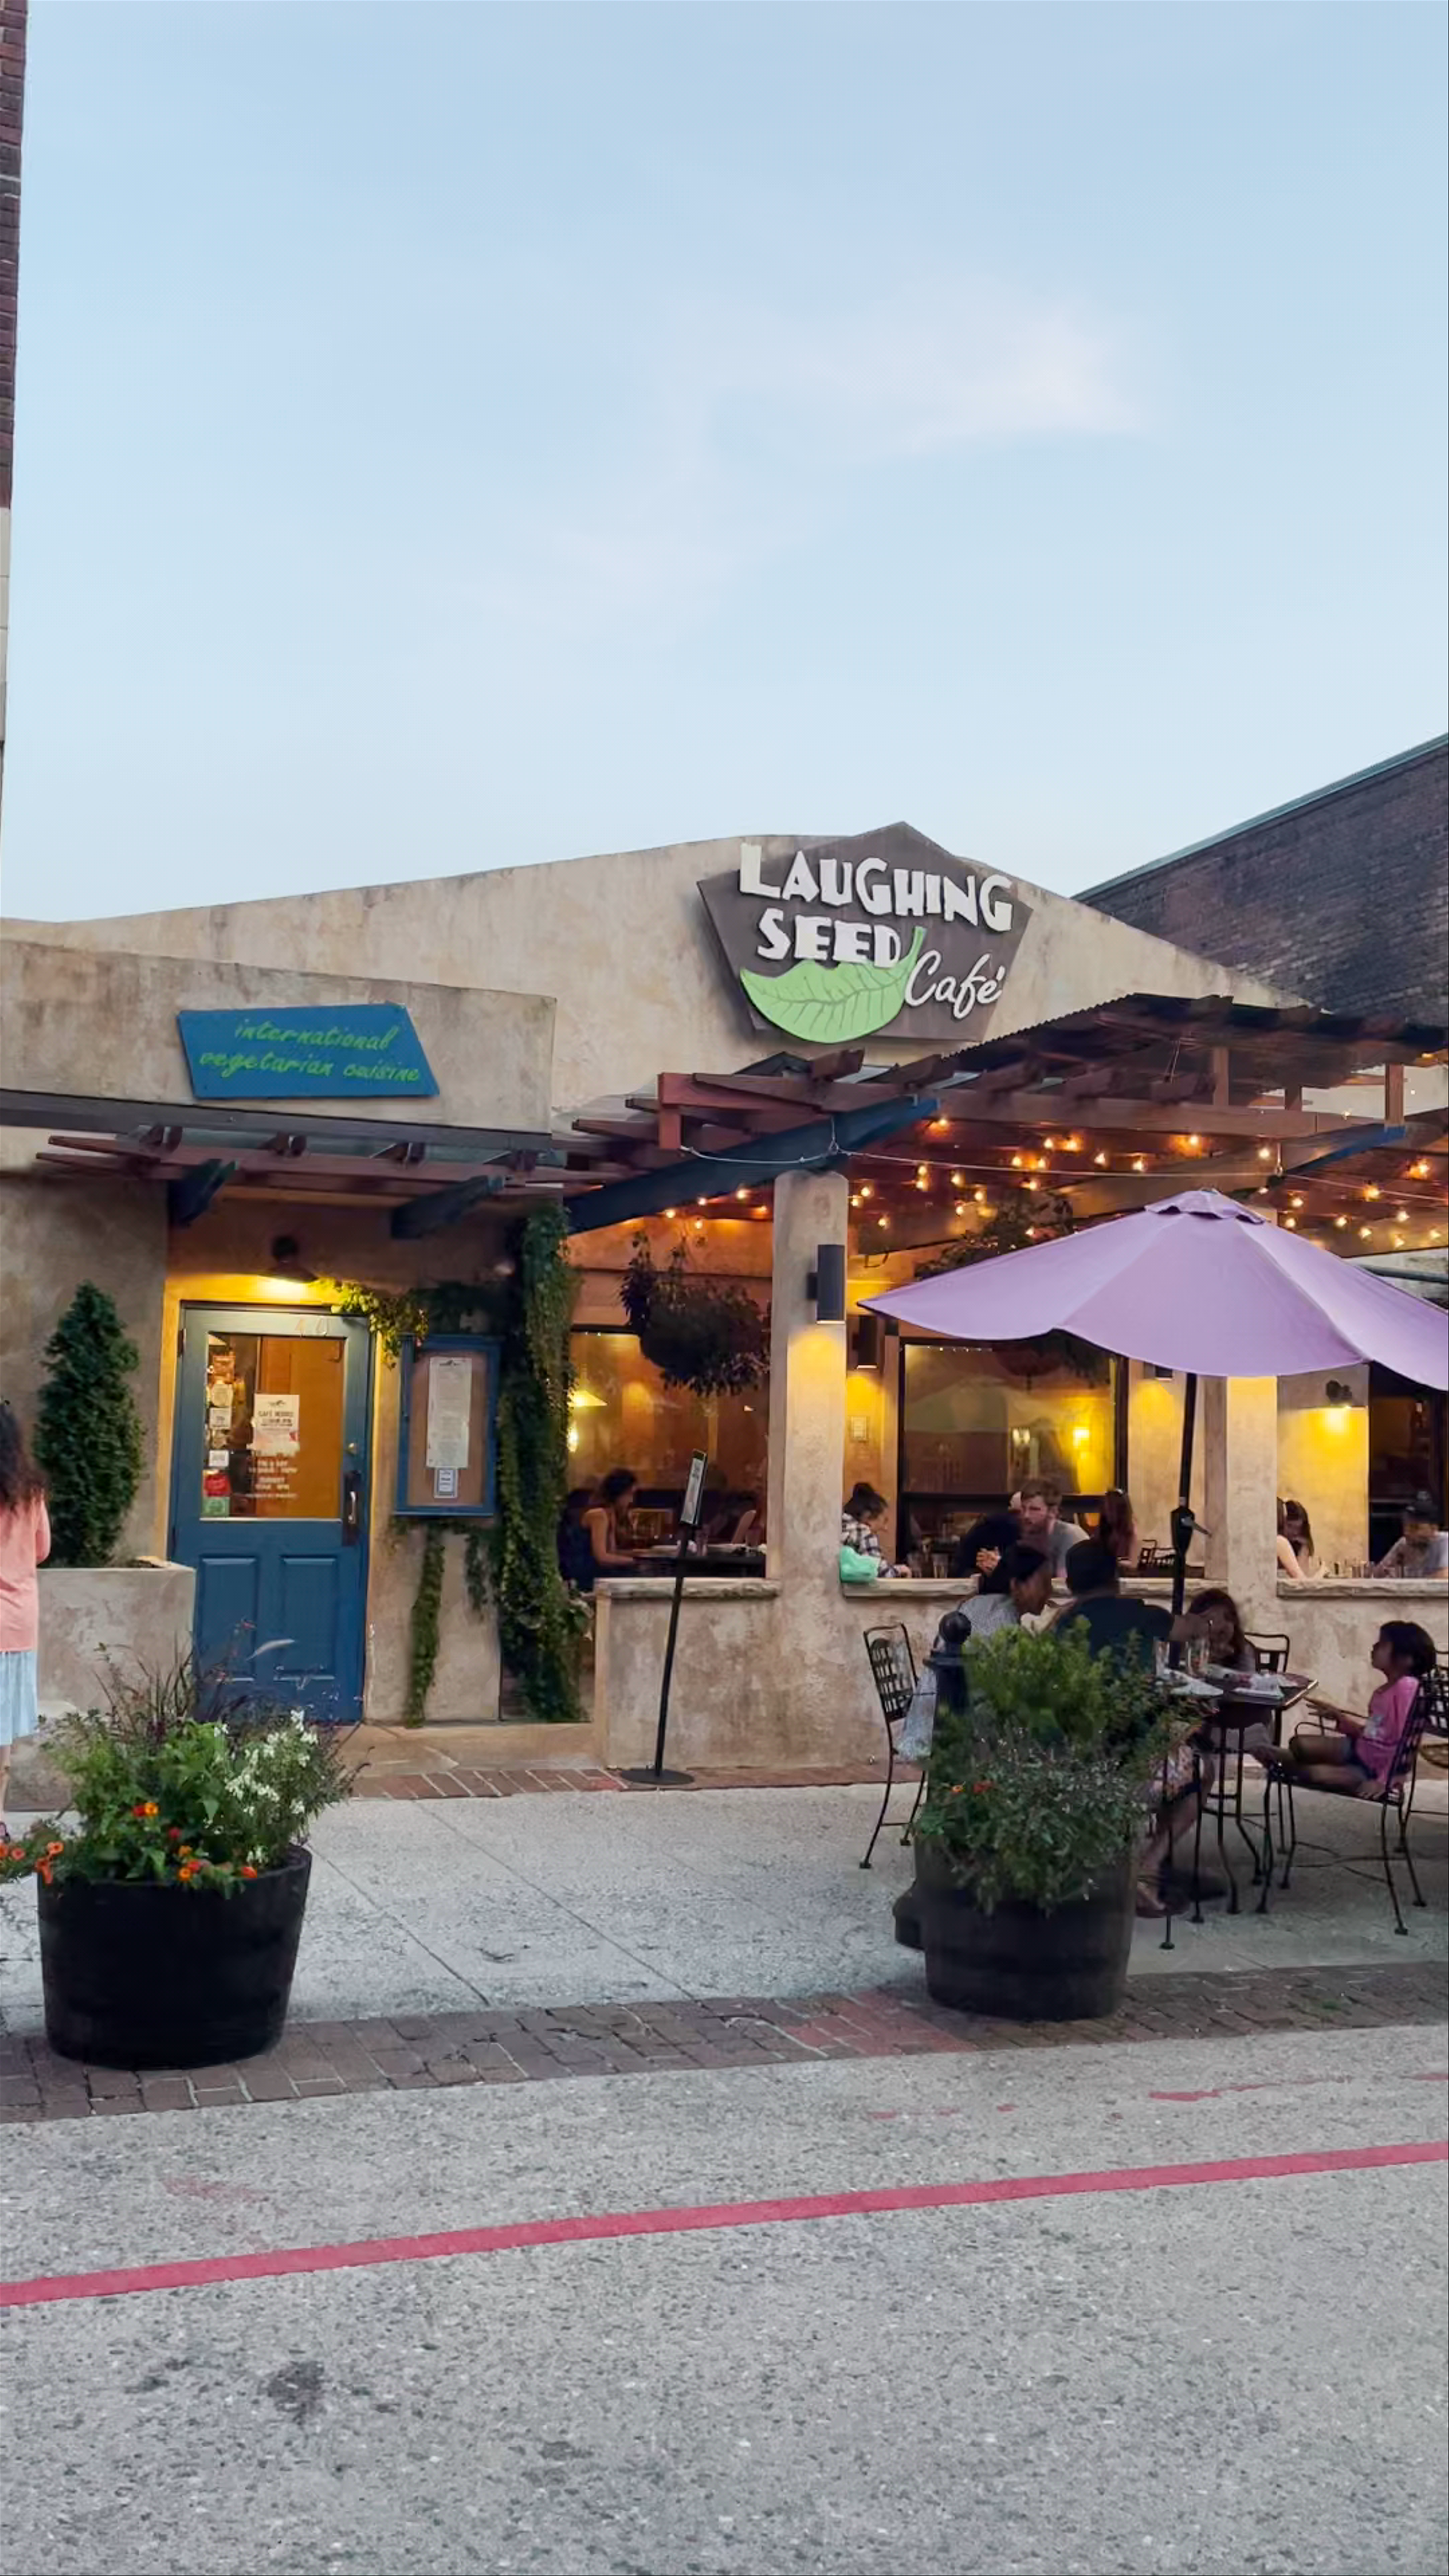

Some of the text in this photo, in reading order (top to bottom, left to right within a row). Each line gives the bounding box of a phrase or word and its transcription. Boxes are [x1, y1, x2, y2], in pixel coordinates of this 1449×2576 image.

[740, 842, 1013, 932] LAUGHING
[757, 908, 901, 969] SEED
[906, 950, 1005, 1019] Café
[235, 1018, 399, 1050] international
[200, 1051, 419, 1081] vegetarian cuisine
